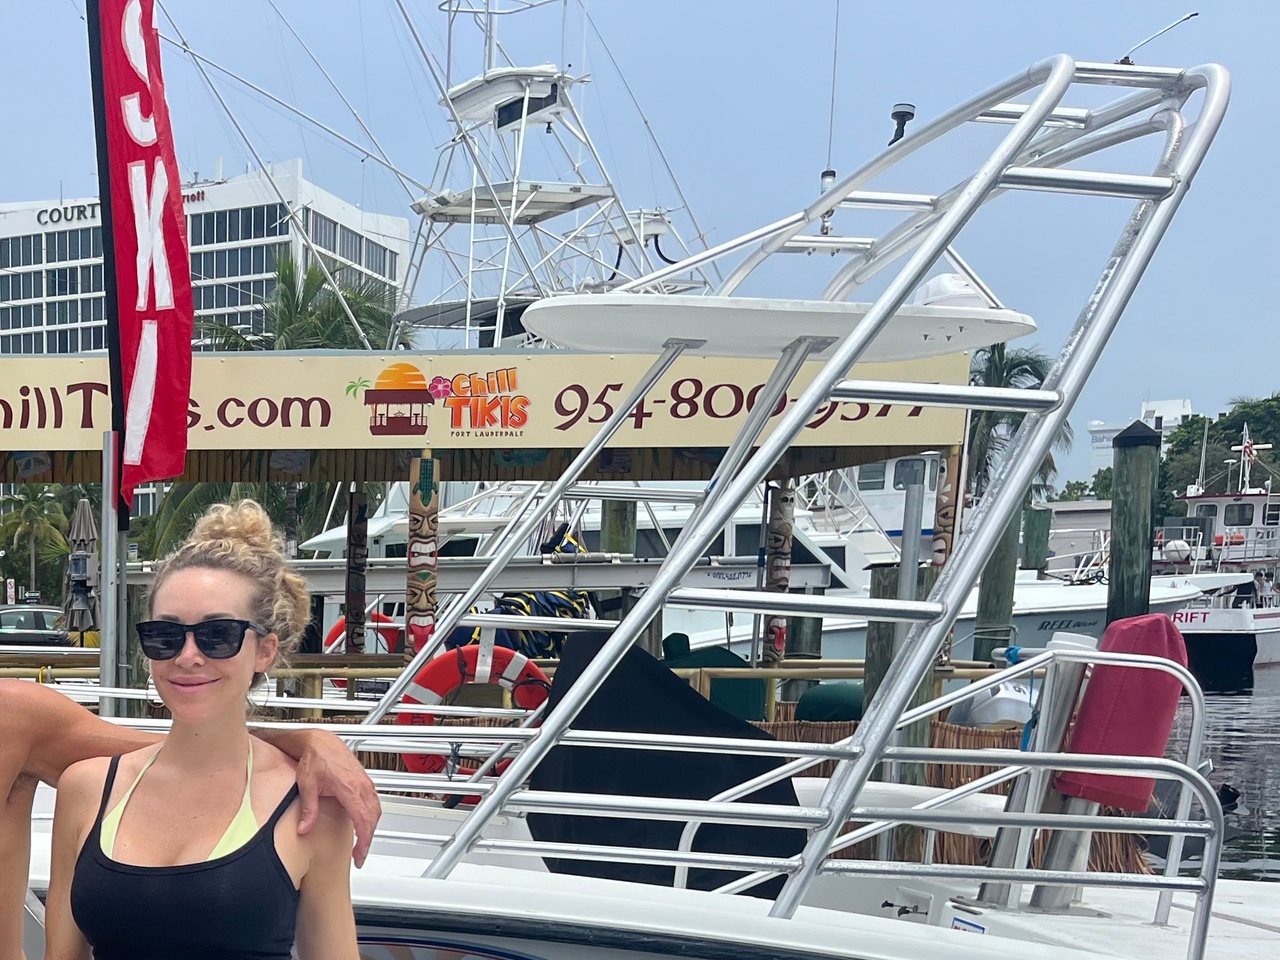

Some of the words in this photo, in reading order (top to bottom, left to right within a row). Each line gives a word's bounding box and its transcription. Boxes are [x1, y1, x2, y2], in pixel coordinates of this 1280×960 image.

[36, 203, 97, 225] COURT
[451, 367, 519, 397] Chill
[443, 395, 532, 429] TIKIS
[1172, 611, 1211, 623] RIFT
